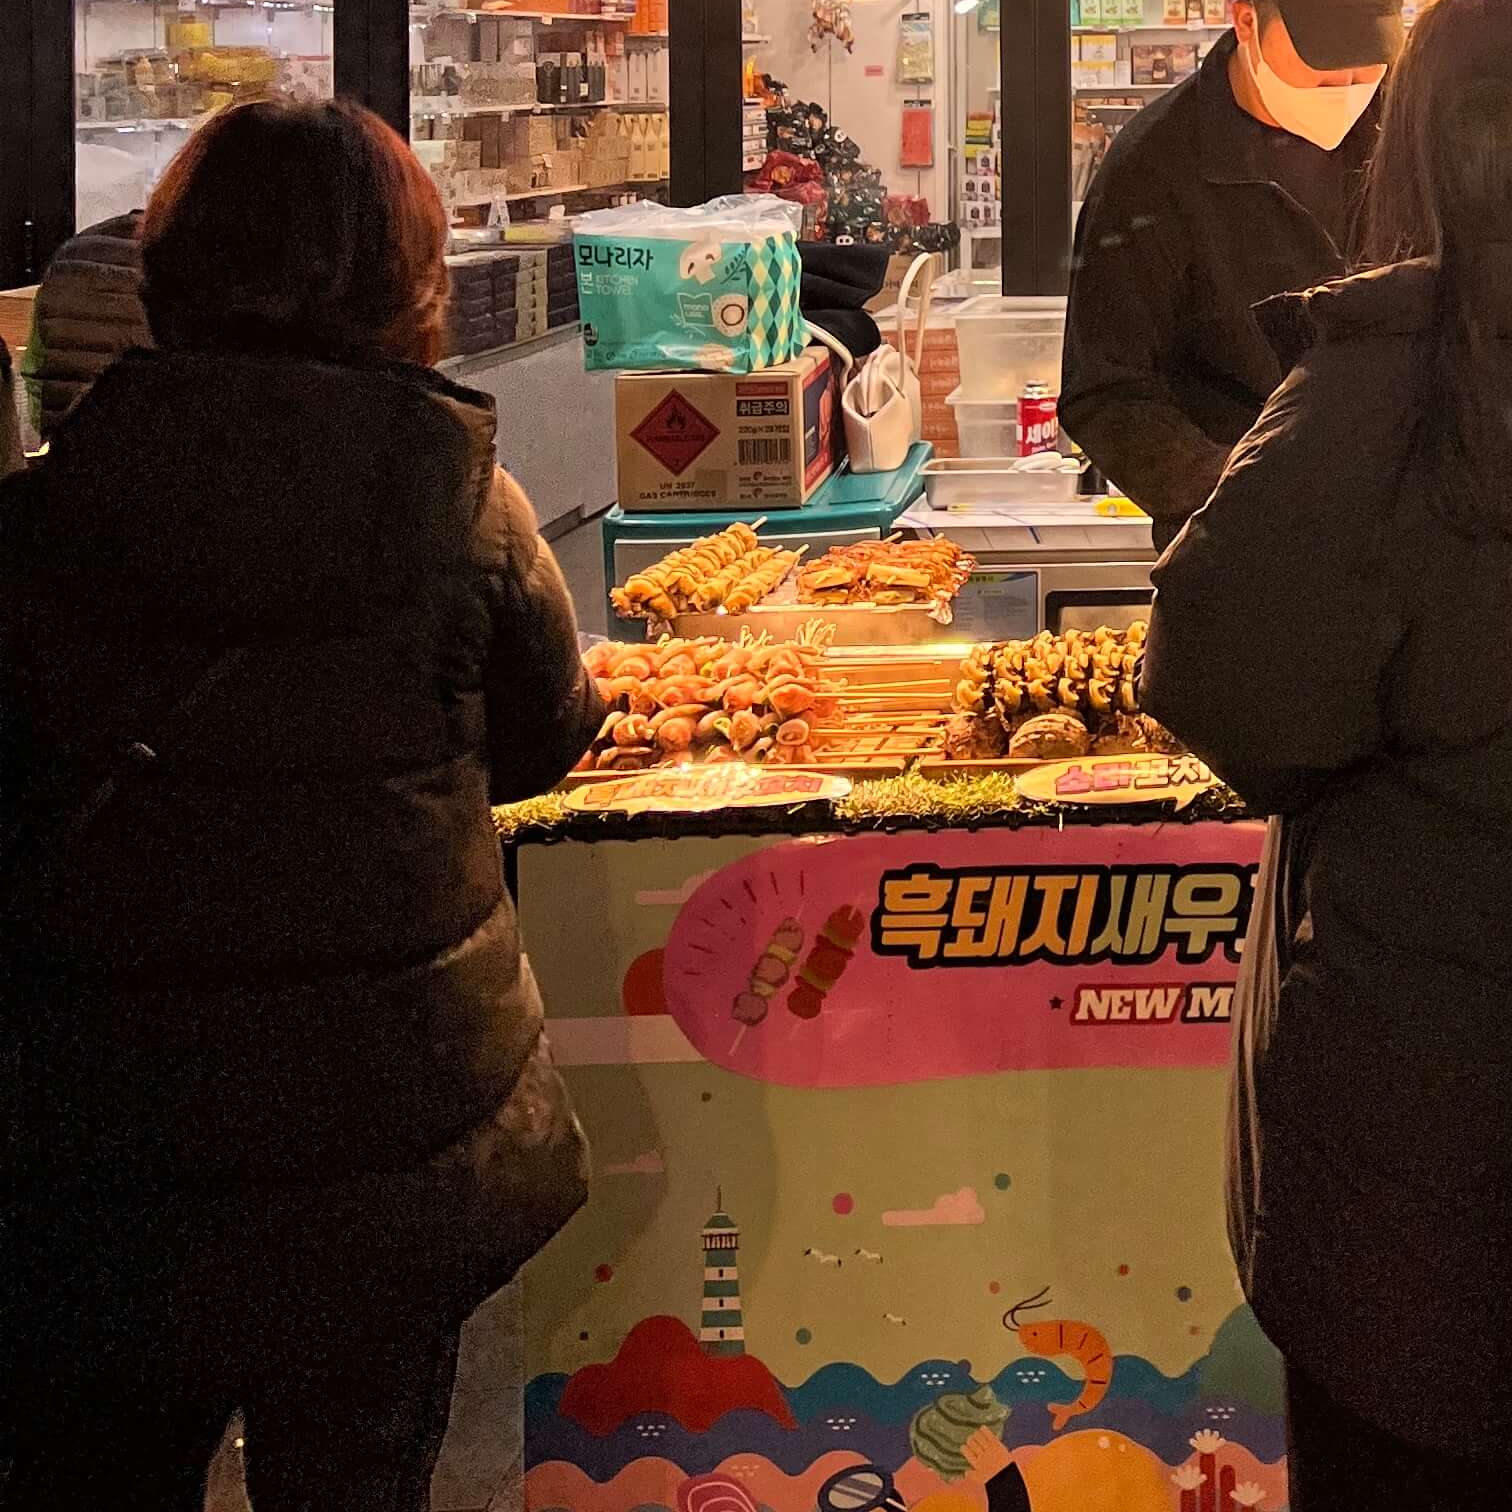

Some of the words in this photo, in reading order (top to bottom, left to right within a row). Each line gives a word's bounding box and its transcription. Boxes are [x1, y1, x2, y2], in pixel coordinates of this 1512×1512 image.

[578, 245, 654, 271] 모나리자
[739, 400, 788, 416] 취급주의
[1056, 755, 1212, 796] 소라꼬치
[880, 873, 1260, 961] 흑돼지새우
[1075, 988, 1181, 1022] NEW
